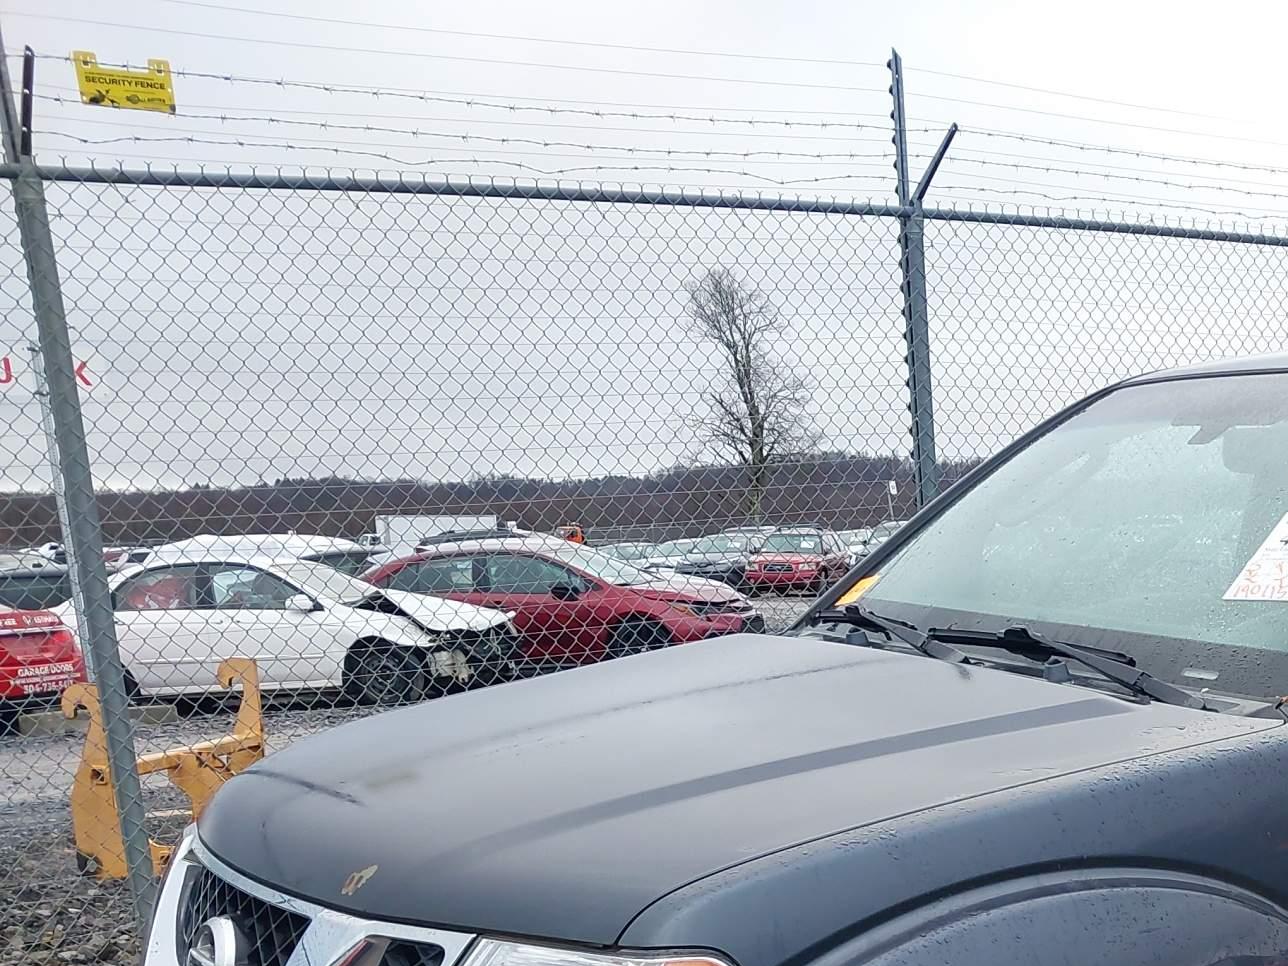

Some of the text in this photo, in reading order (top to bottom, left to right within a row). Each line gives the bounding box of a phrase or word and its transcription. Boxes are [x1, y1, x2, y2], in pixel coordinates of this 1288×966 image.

[84, 75, 133, 87] SECURITY
[134, 81, 166, 90] FENCE
[17, 665, 50, 677] GARAGE
